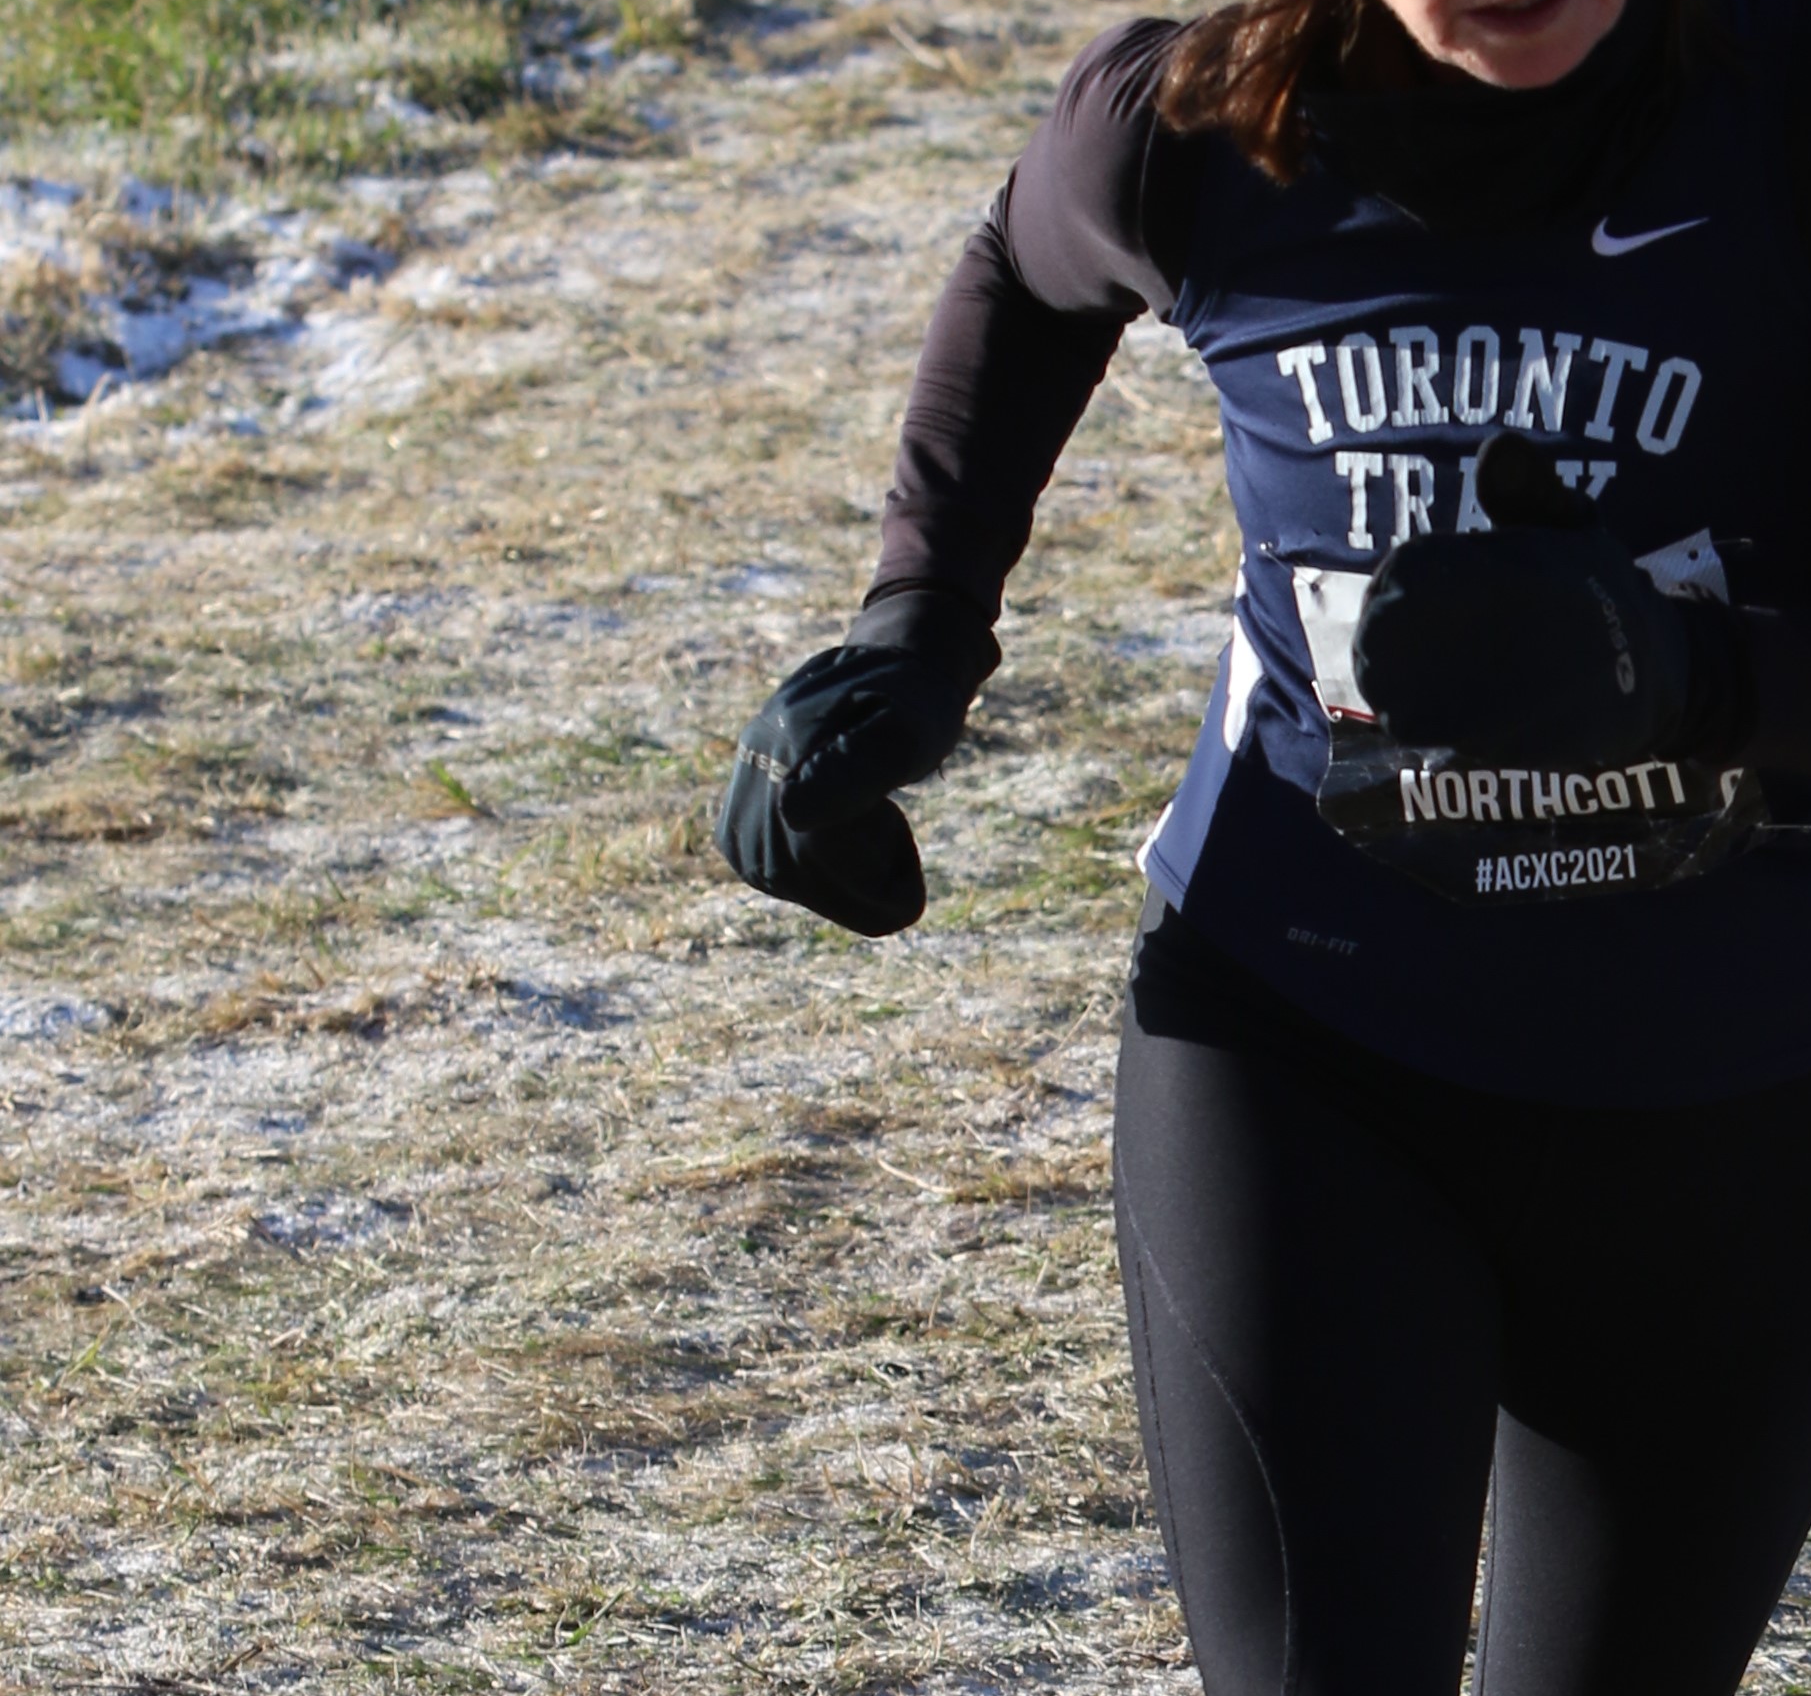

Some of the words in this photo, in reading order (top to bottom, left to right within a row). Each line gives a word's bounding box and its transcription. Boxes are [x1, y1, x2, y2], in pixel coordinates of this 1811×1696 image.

[1276, 325, 1703, 456] TORONTO
[1334, 450, 1618, 551] TRA
[1399, 761, 1687, 824] NORTHCOTT
[1474, 843, 1638, 894] #ACXC2021
[1286, 926, 1360, 956] DRI-FIT
